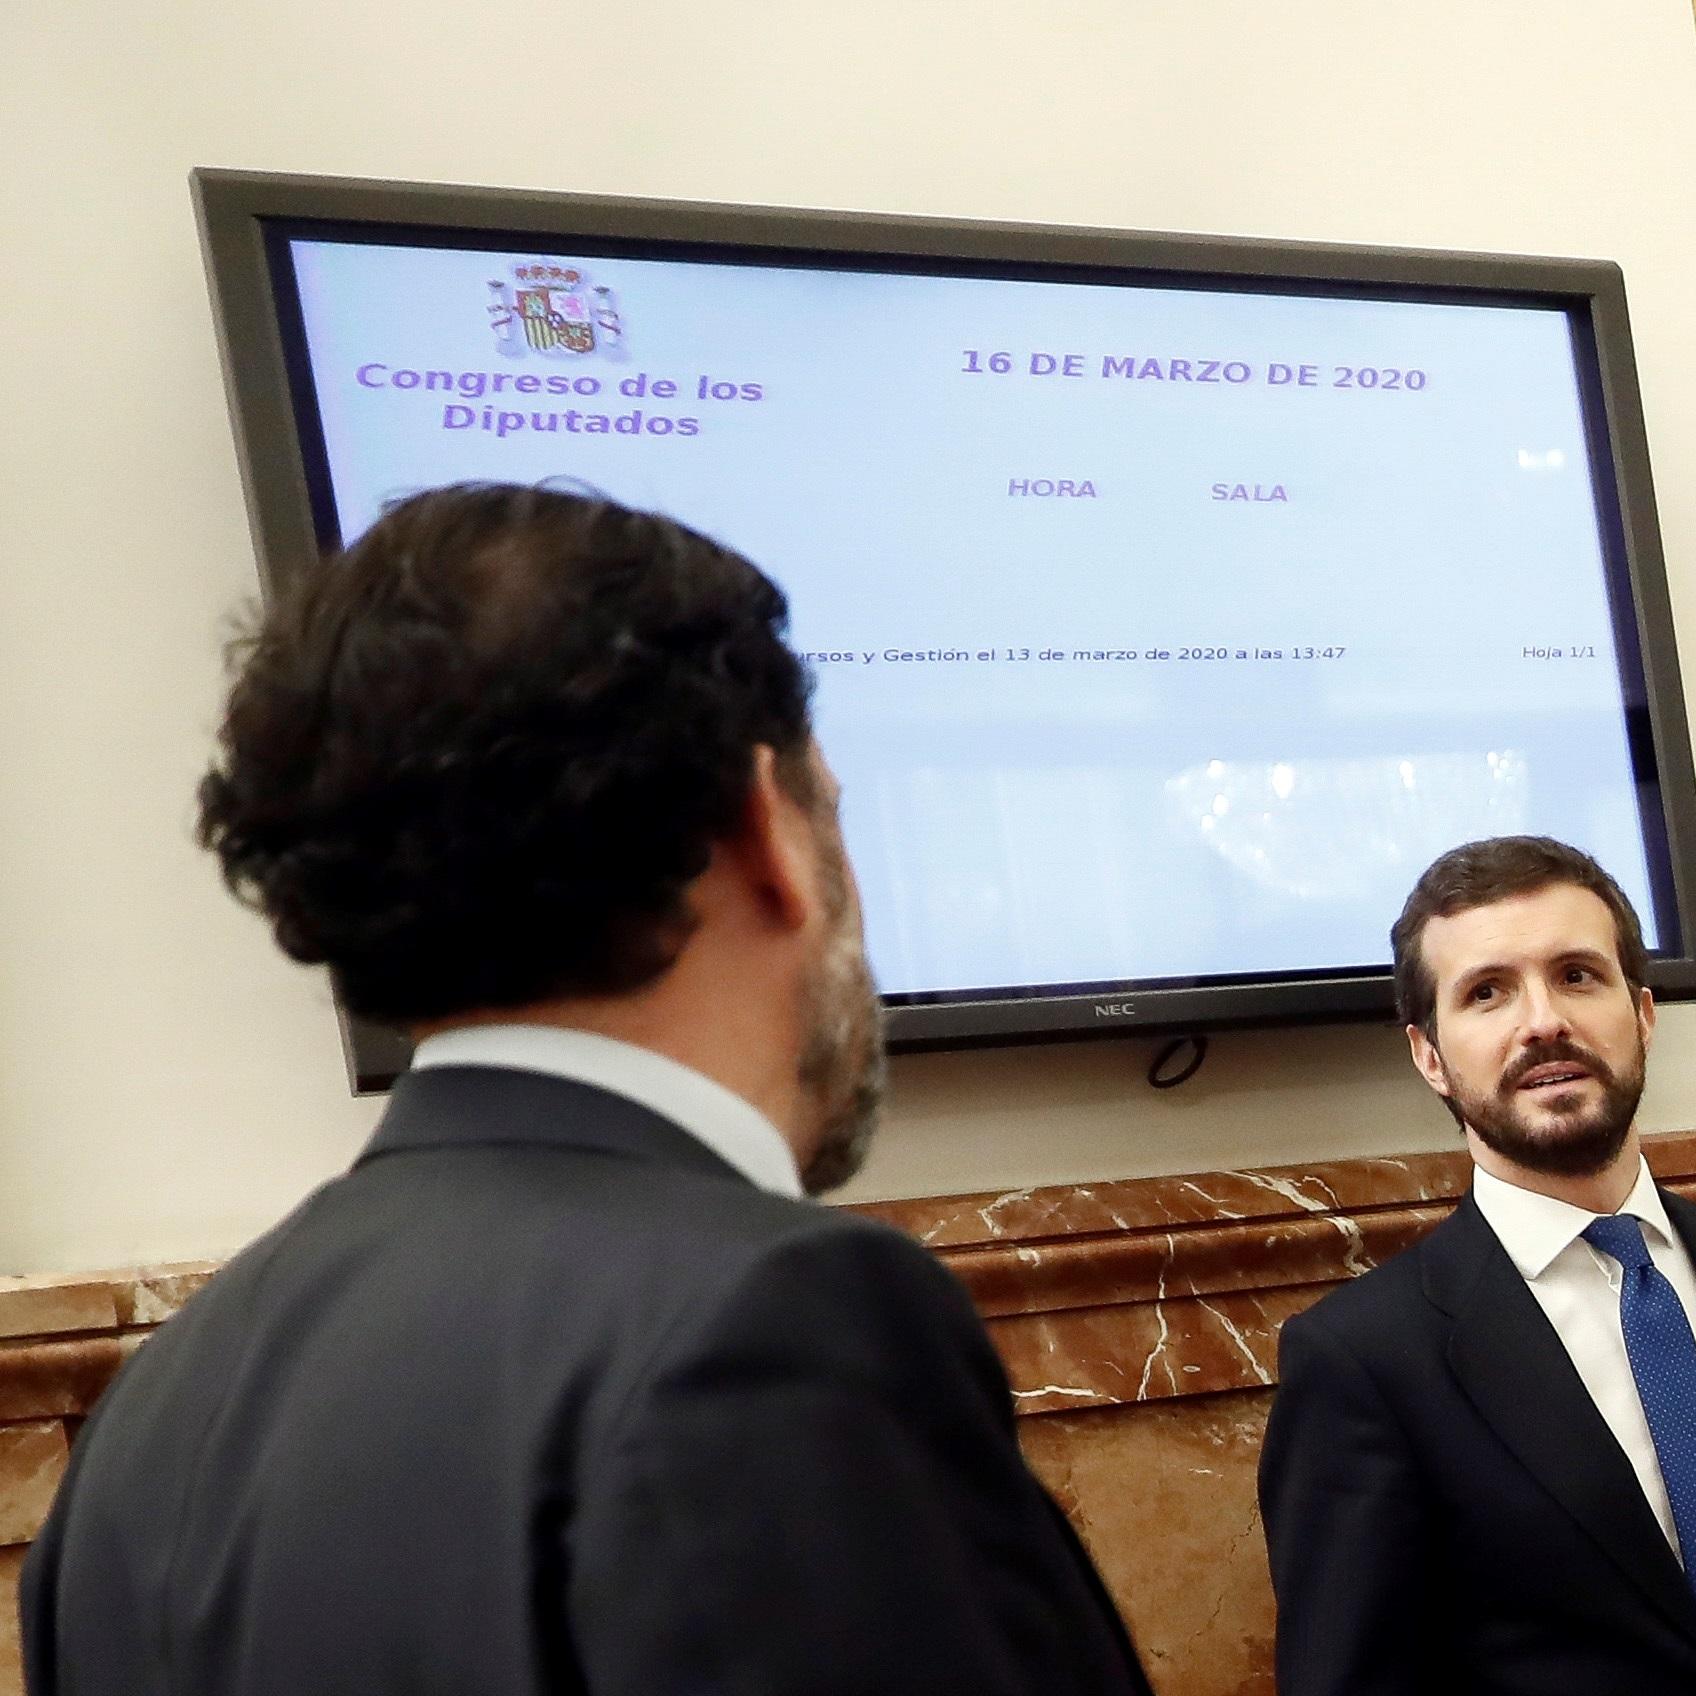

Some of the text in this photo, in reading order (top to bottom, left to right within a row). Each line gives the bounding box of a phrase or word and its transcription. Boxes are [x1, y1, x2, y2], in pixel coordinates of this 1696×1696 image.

[961, 350, 1427, 391] 16 DE MARZO DE 2020
[356, 362, 763, 401] Congreso de los
[443, 404, 700, 437] Diputados
[1008, 479, 1097, 498] HORA
[1211, 484, 1288, 502] SALA
[863, 652, 875, 664] y
[883, 648, 969, 662] Gestión
[977, 649, 995, 661] el
[1006, 649, 1030, 661] 13
[1039, 648, 1065, 661] de
[1073, 648, 1138, 661] marzo
[1145, 647, 1170, 660] de
[1177, 647, 1228, 660] 2020
[1235, 649, 1247, 660] a
[1255, 648, 1283, 660] las
[1292, 647, 1346, 660] 13:47
[1522, 646, 1595, 660] Hoja 1/1
[1095, 1003, 1136, 1017] NEC
